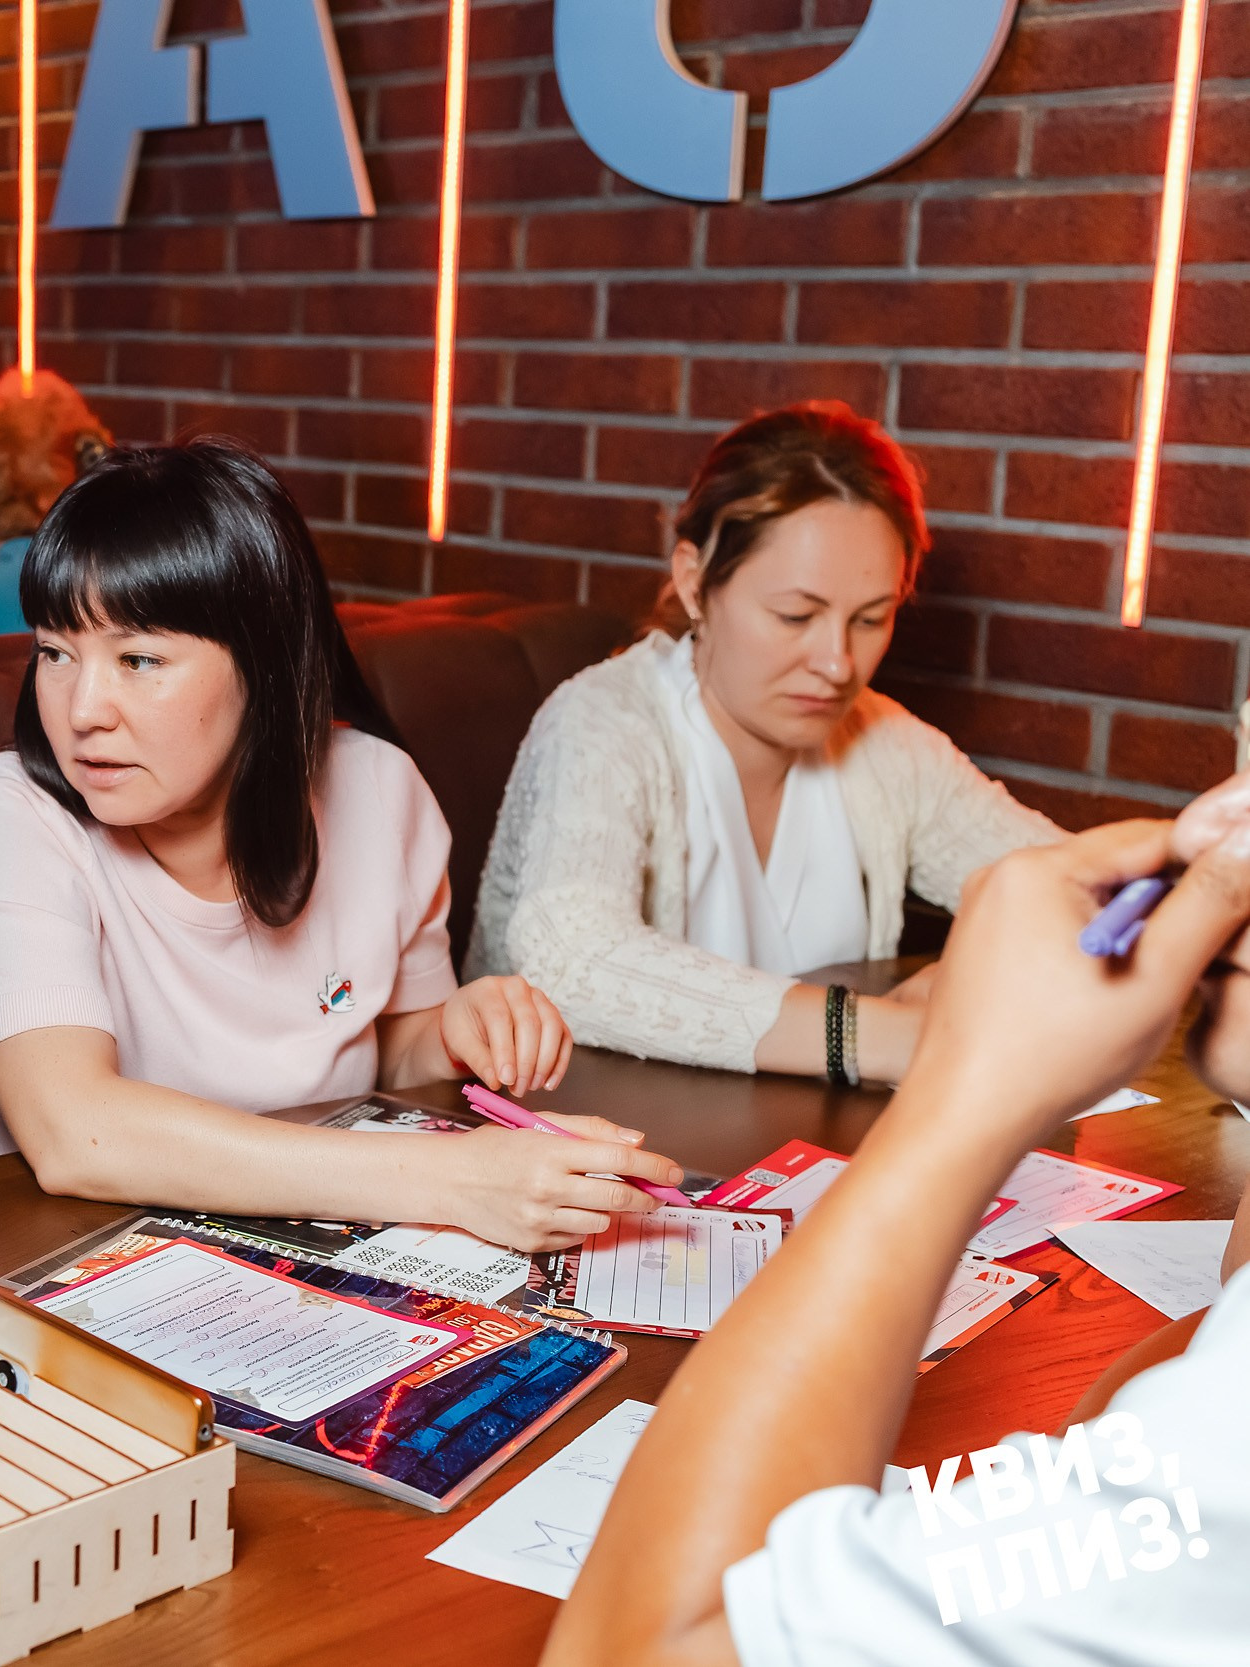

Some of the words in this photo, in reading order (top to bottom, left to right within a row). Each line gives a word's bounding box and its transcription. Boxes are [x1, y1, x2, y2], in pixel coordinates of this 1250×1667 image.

[354, 1250, 371, 1260] 000
[361, 1253, 378, 1263] 000
[368, 1257, 385, 1266] 000
[384, 1262, 401, 1272] 000
[396, 1263, 412, 1272] 000
[404, 1265, 421, 1275] 000
[420, 1268, 437, 1278] 000
[430, 1274, 447, 1284] 000
[448, 1277, 465, 1287] 000
[458, 1279, 474, 1289] 000
[466, 1282, 483, 1292] 000
[477, 1284, 494, 1293] 000
